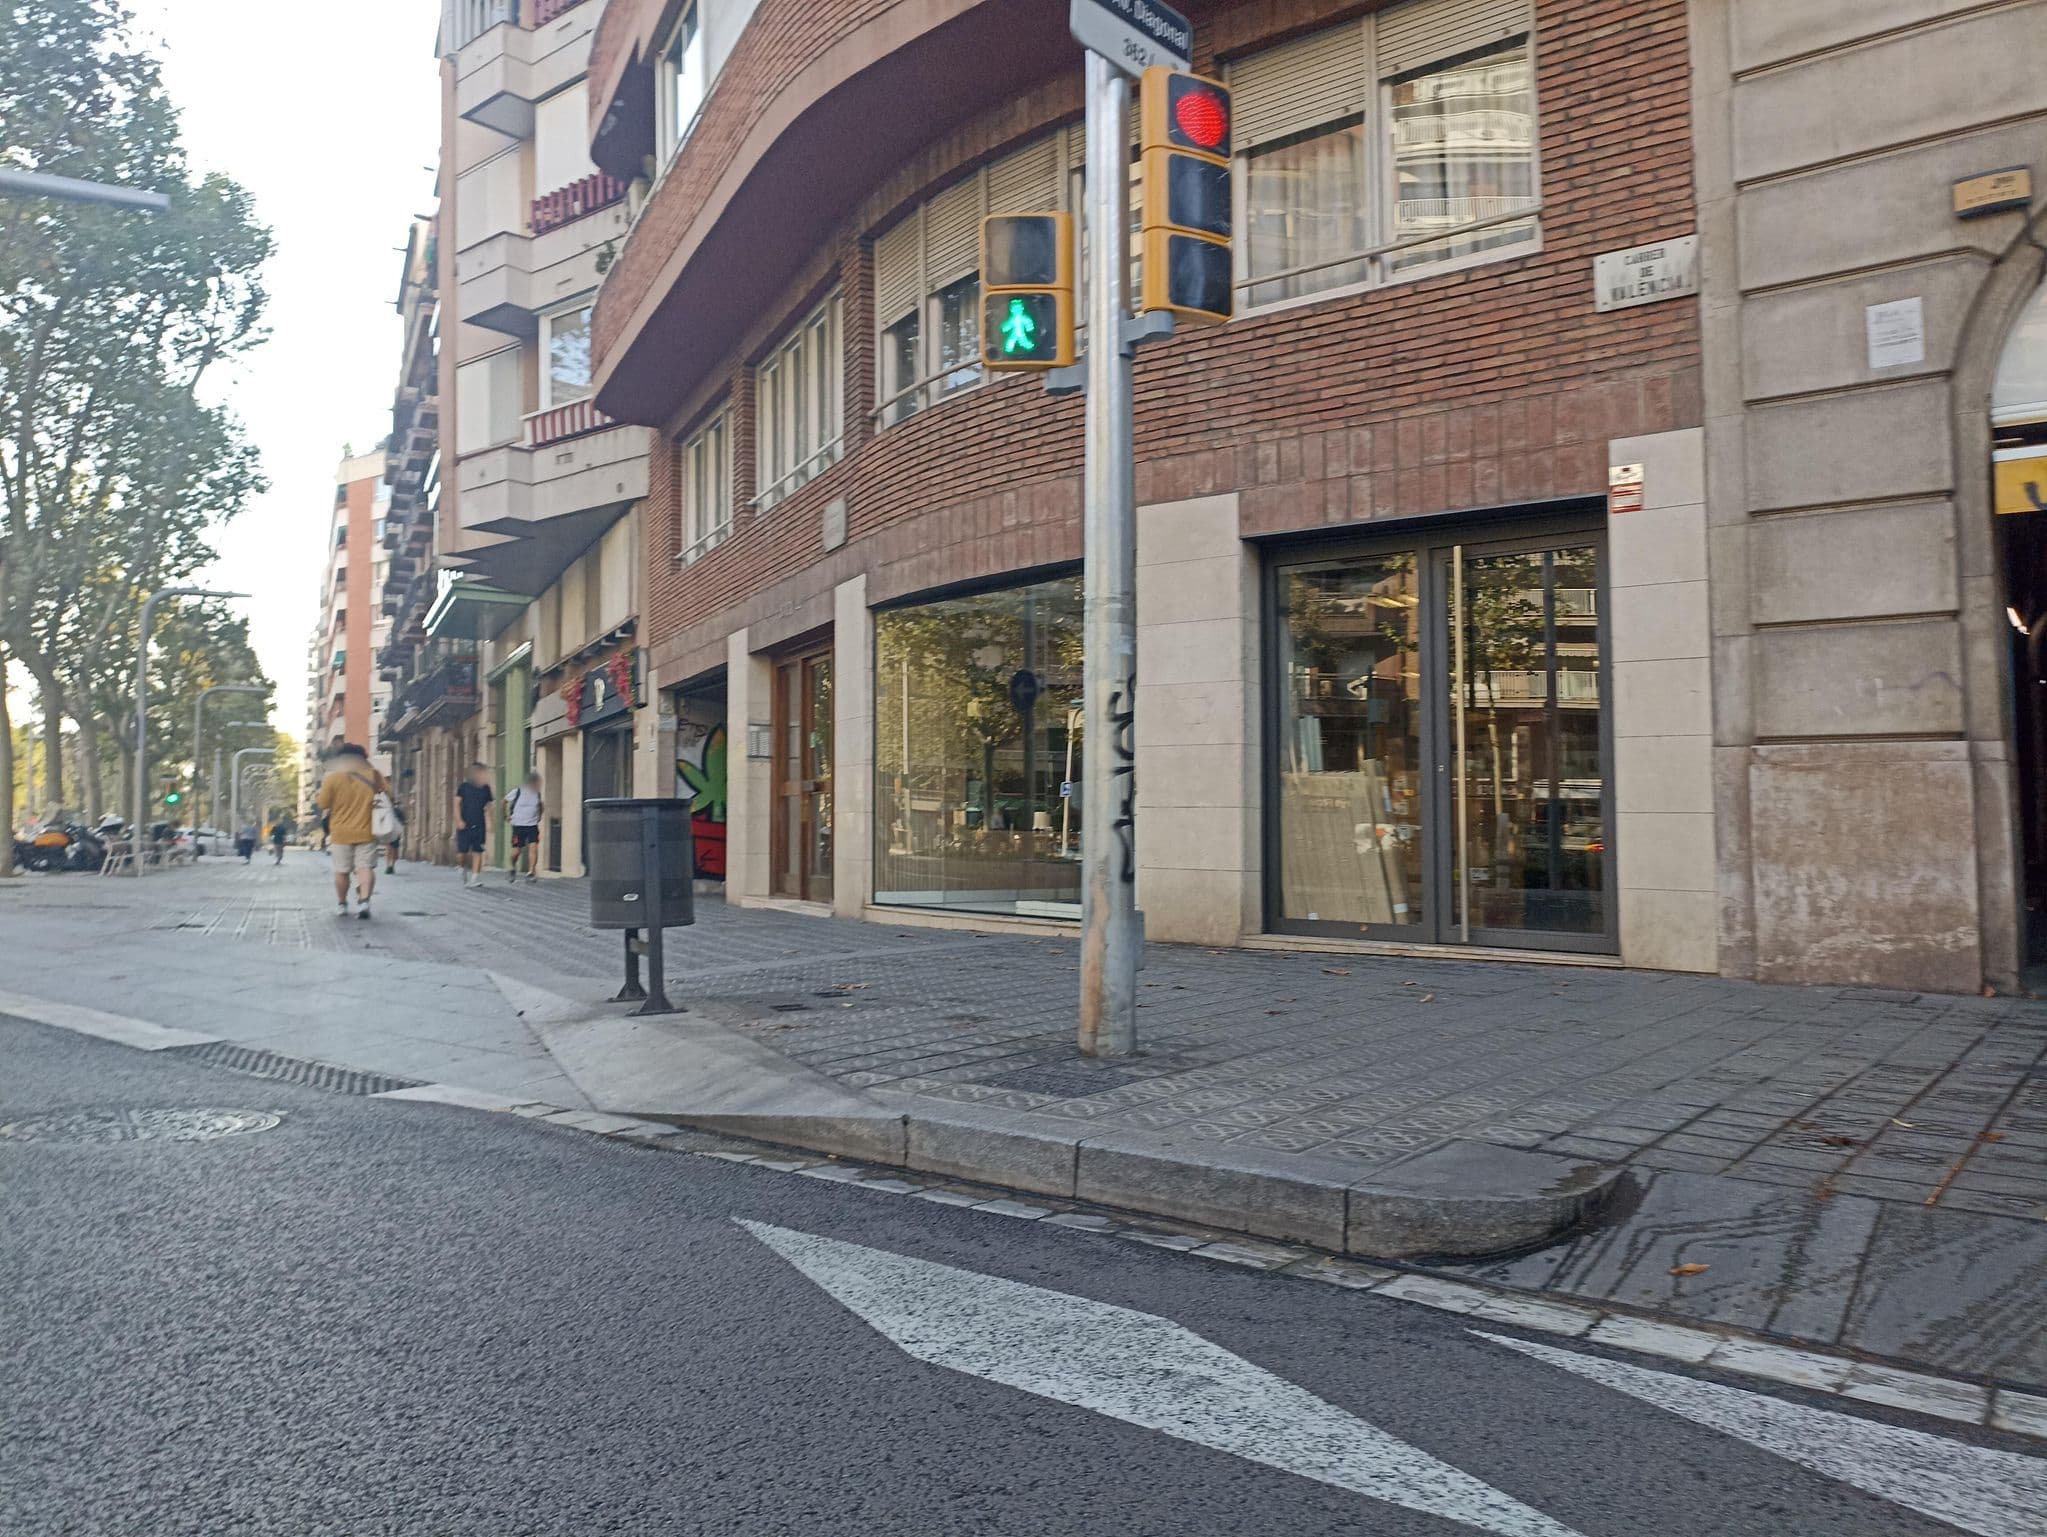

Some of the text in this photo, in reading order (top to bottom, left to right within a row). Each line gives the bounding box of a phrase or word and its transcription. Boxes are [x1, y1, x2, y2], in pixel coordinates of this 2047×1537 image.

[1111, 0, 1188, 50] v. Diagonal
[1624, 248, 1666, 266] CARRER
[1639, 265, 1654, 278] DE
